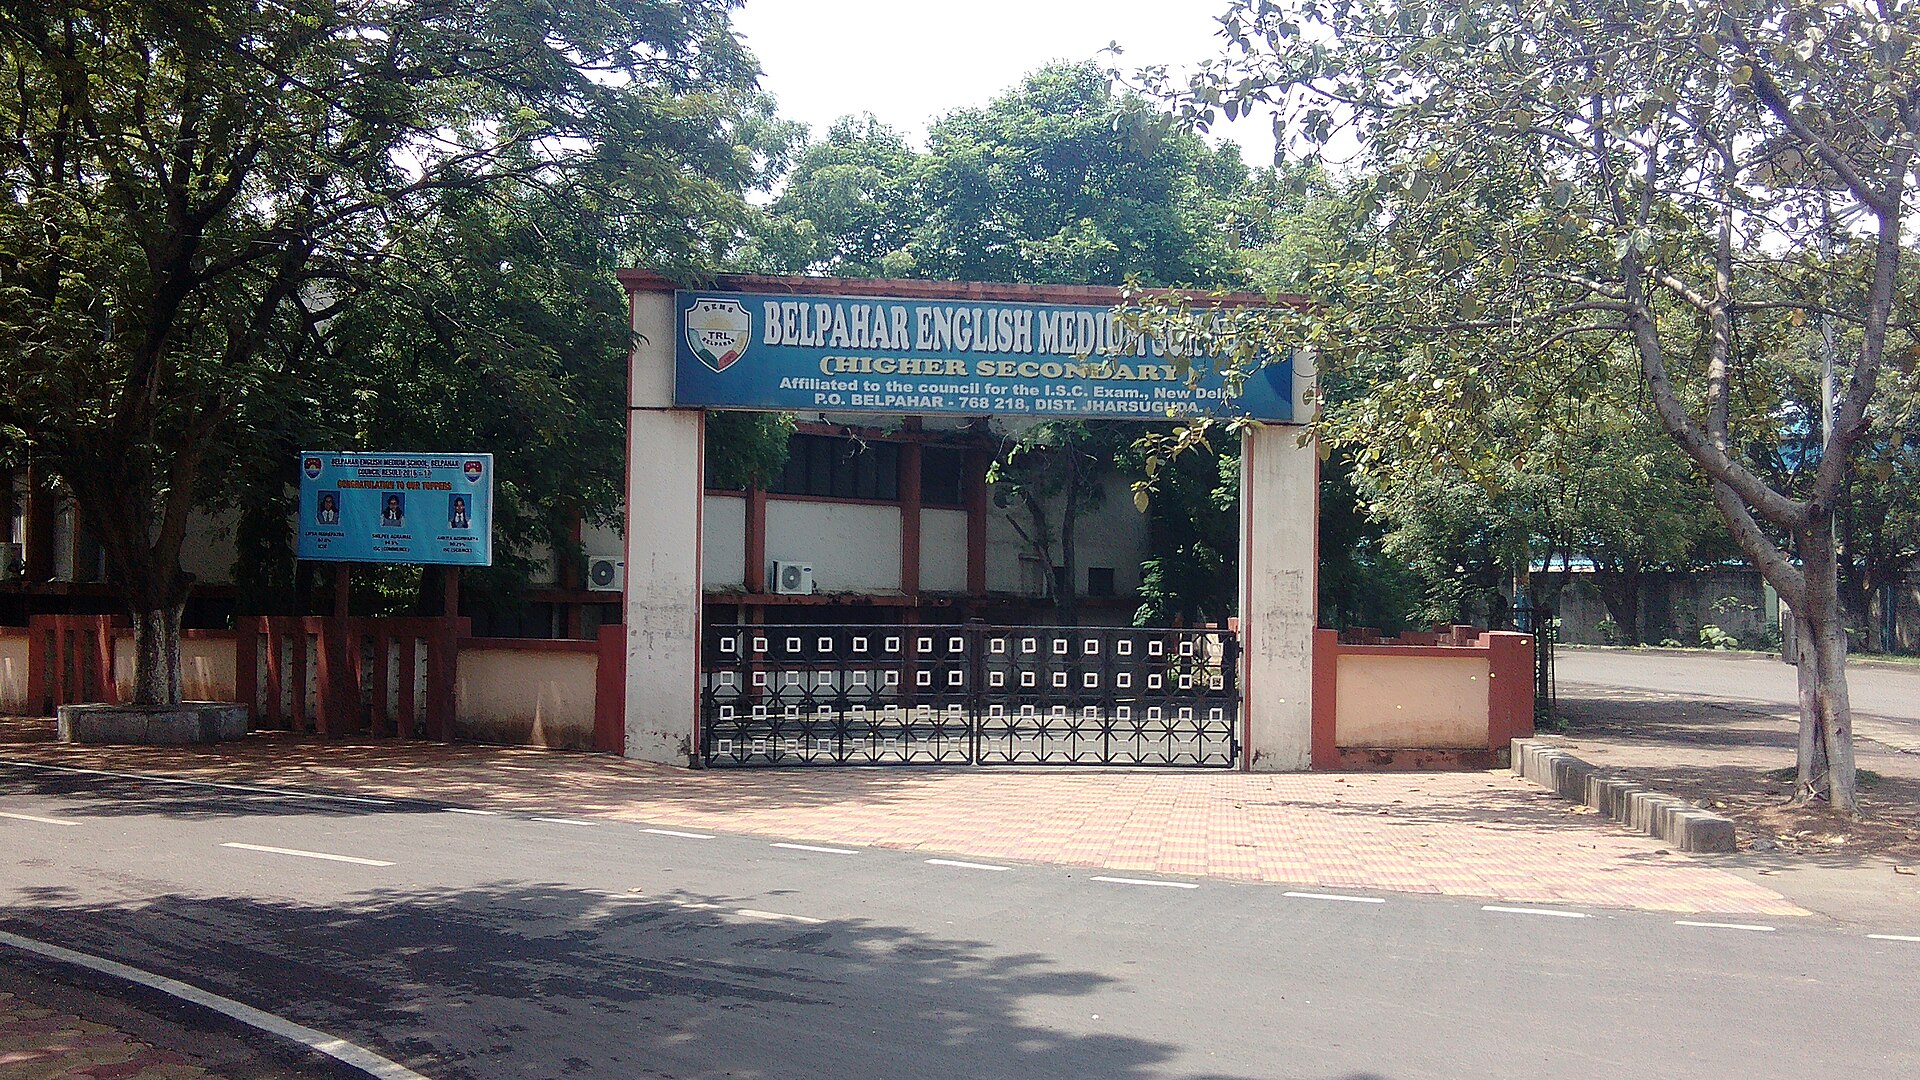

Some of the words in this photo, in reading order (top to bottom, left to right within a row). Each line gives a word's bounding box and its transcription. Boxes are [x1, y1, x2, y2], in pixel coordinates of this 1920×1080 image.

[703, 303, 733, 313] BEMS
[763, 301, 910, 350] BELPAHAR
[915, 306, 1033, 353] ENGLISH
[707, 331, 731, 340] TRL
[819, 355, 969, 376] (HIGHER
[779, 377, 858, 391] Affiliated
[863, 380, 881, 392] to
[886, 381, 913, 393] the
[918, 382, 980, 395] council
[984, 383, 1009, 396] for
[1012, 384, 1040, 397] the
[1044, 385, 1089, 397] I.S.C.
[1093, 386, 1149, 400] Exam.,
[1154, 387, 1191, 399] New
[814, 393, 846, 405] P.O.
[851, 394, 944, 407] BELPAHAR
[959, 396, 990, 409] 768
[994, 397, 1030, 412] 218,
[1035, 399, 1077, 411] DIST.
[331, 458, 359, 467] BELPAHAR
[360, 458, 383, 467] ENGLISH
[383, 459, 406, 467] MEDIUM
[382, 469, 402, 477] RESULT
[396, 481, 404, 489] TO
[406, 481, 420, 490] OUR
